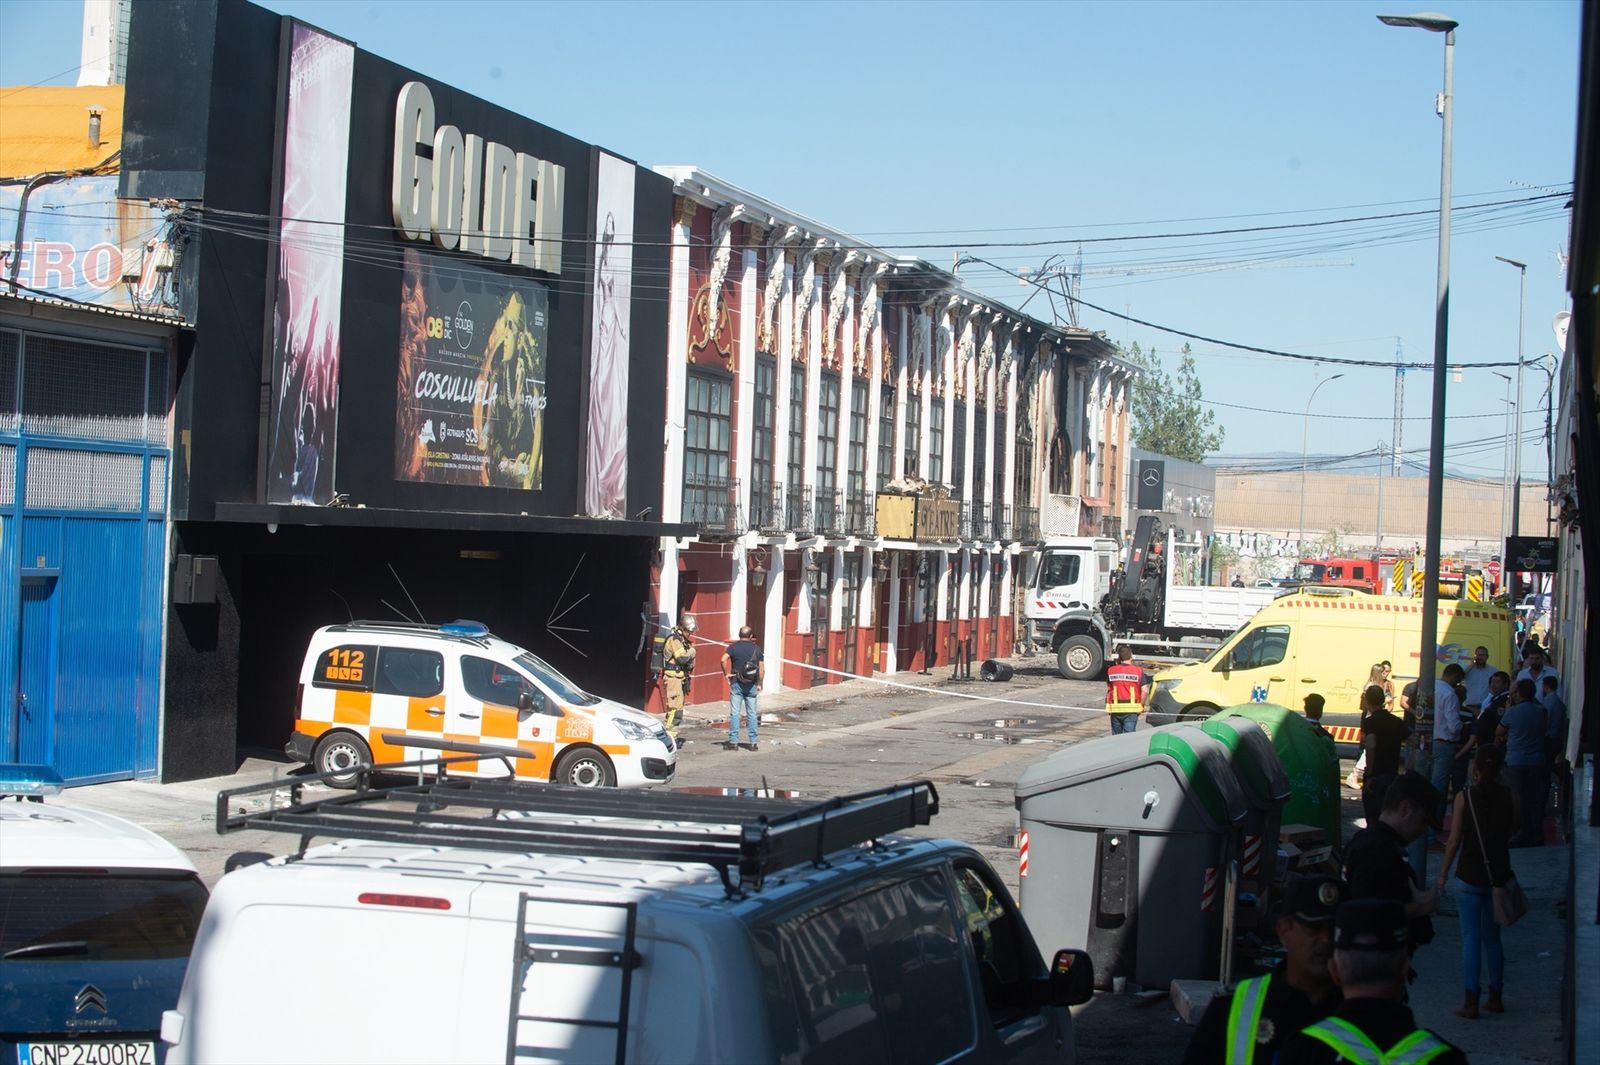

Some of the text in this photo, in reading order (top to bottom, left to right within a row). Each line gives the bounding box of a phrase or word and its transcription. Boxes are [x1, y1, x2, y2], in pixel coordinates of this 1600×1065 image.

[392, 81, 566, 275] GOLDEN
[426, 316, 444, 338] 08
[415, 371, 498, 405] COSCULLUELA
[328, 648, 365, 668] 112
